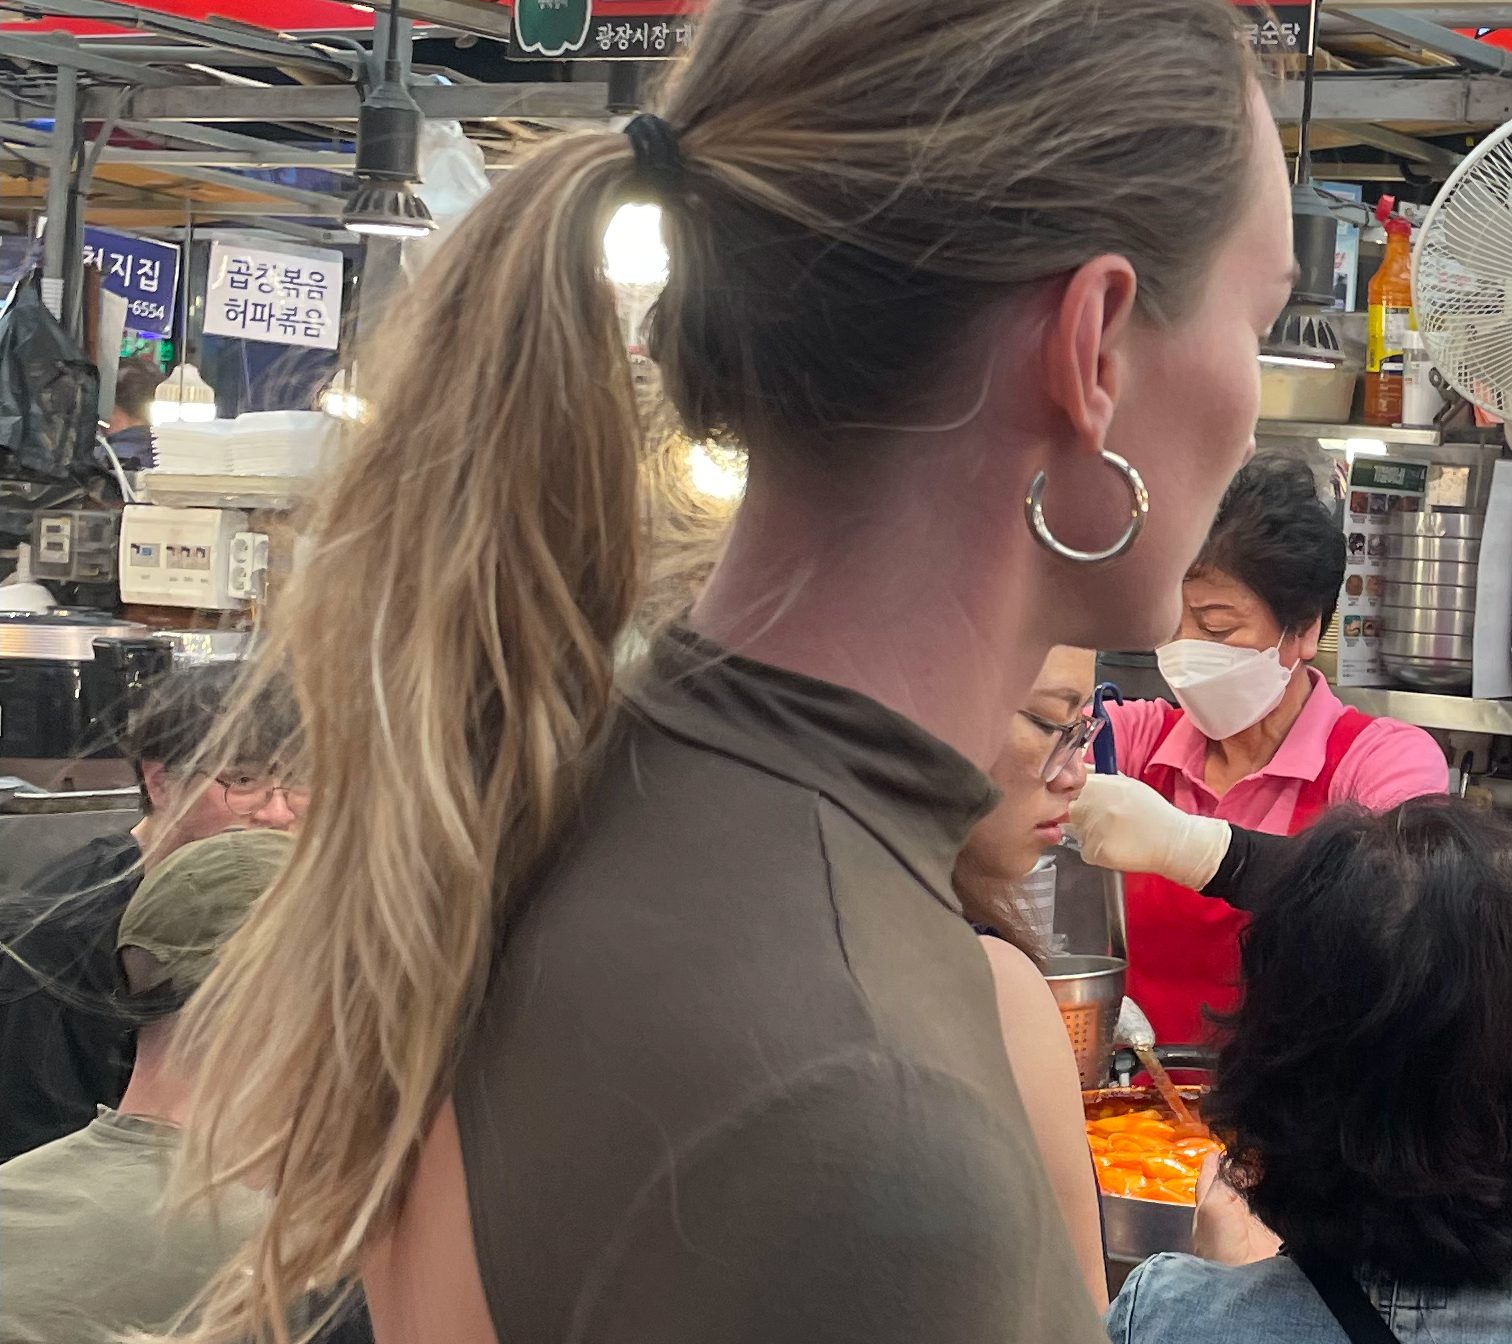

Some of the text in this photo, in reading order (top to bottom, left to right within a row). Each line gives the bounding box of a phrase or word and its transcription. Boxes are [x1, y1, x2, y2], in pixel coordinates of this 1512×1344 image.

[595, 22, 670, 51] 광장시장
[227, 258, 328, 301] 곱창볶음
[224, 297, 325, 339] 허파볶음
